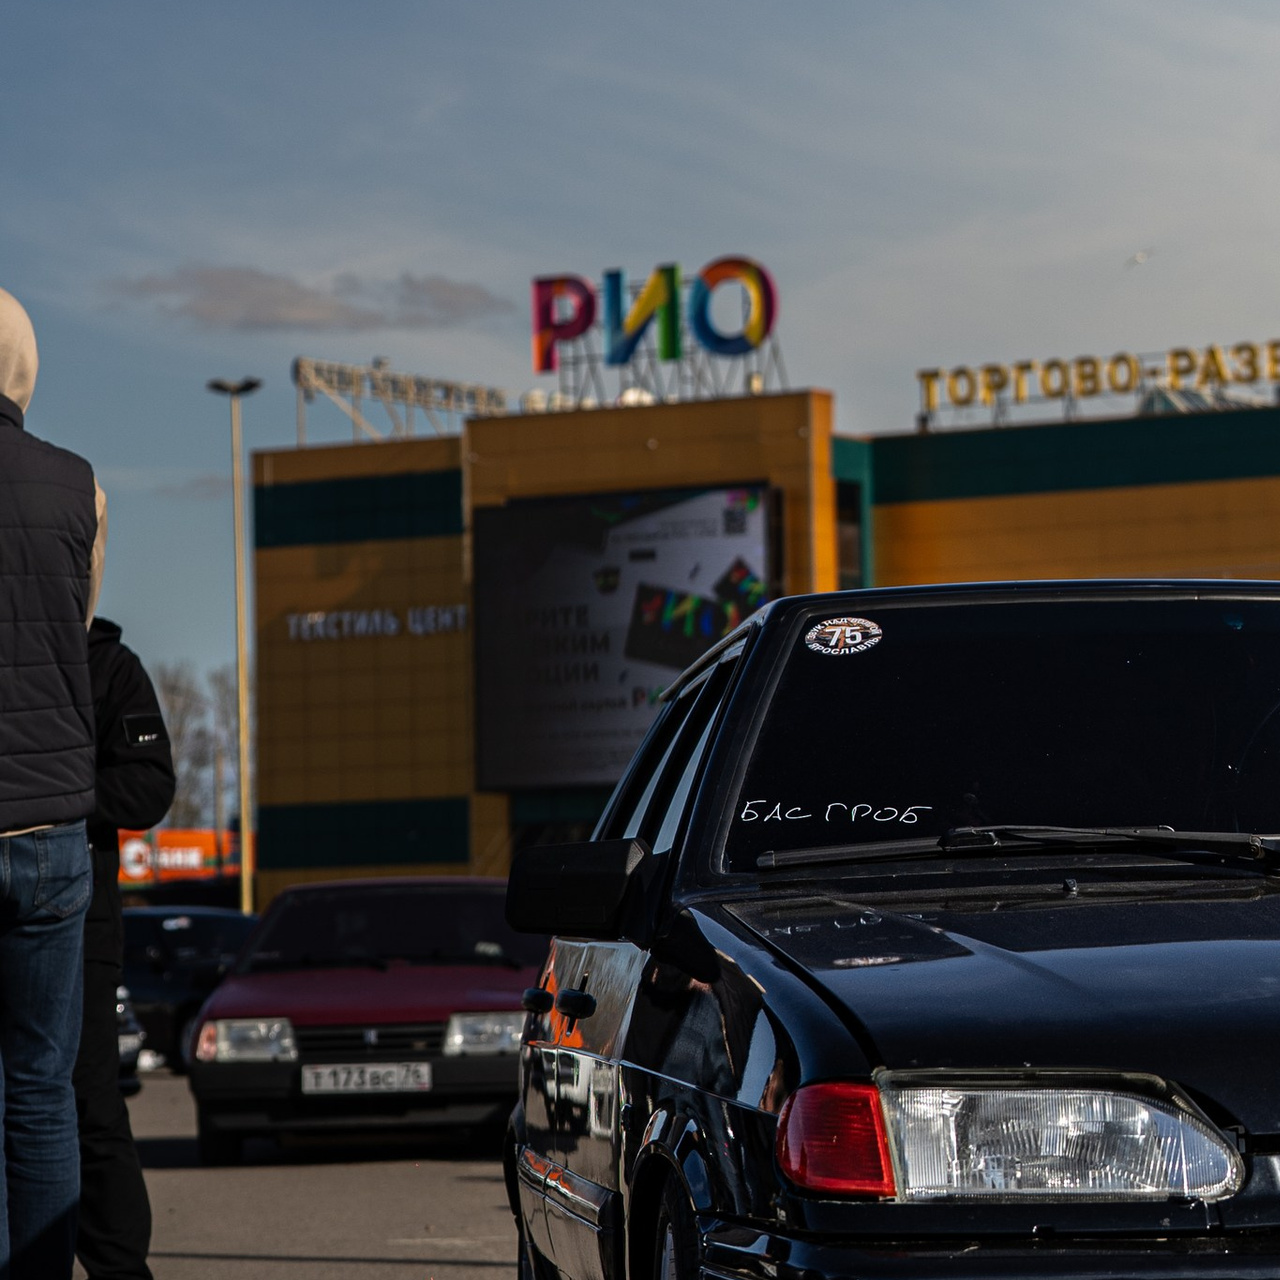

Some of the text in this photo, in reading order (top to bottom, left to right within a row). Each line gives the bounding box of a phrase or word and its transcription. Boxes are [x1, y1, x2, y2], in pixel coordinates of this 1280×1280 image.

[532, 254, 778, 374] РИО
[808, 637, 880, 655] ЯРОСЛАВЛЬ
[825, 626, 863, 647] 75
[741, 800, 933, 824] БАС ГРОБ
